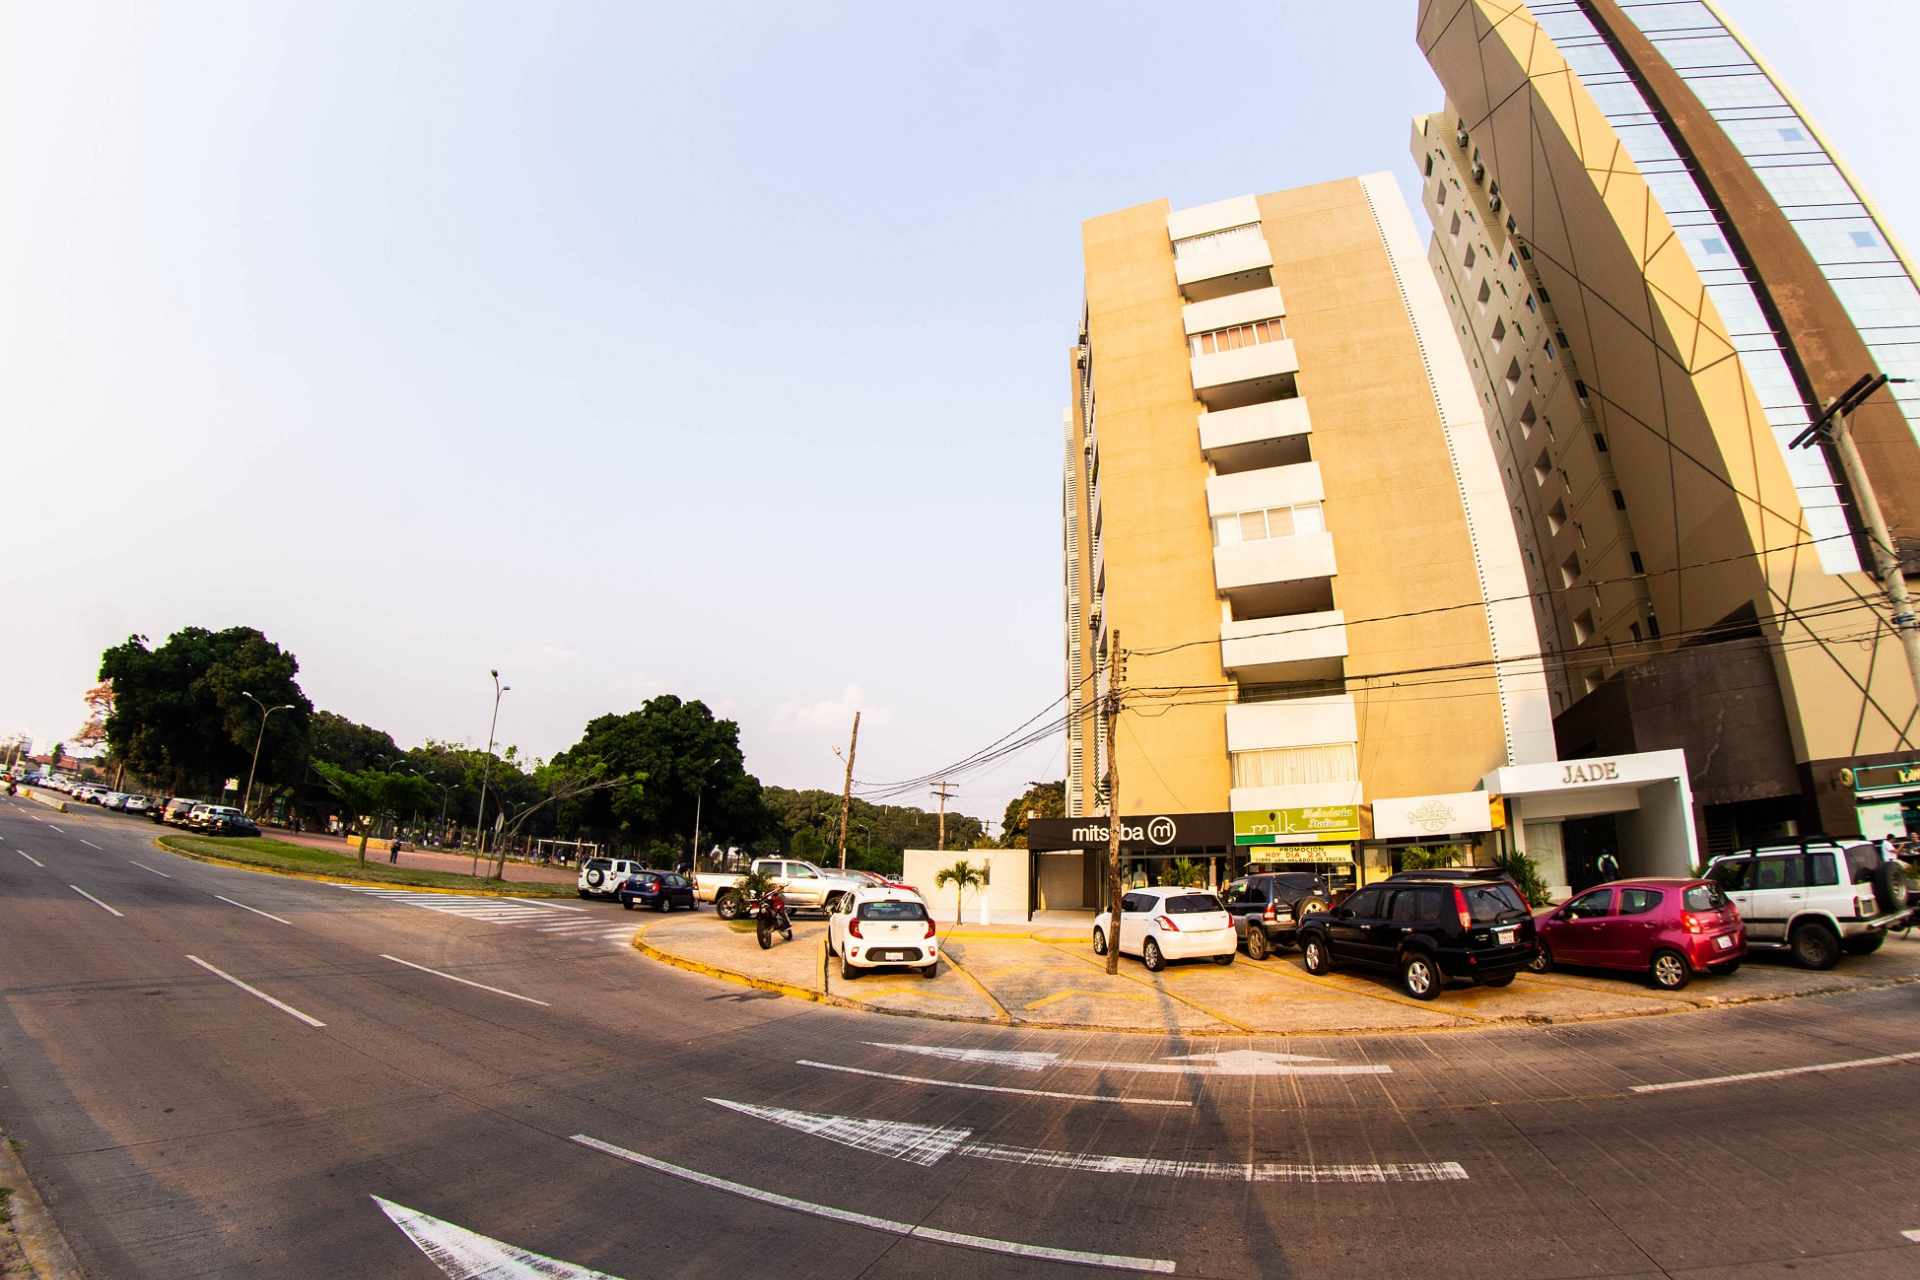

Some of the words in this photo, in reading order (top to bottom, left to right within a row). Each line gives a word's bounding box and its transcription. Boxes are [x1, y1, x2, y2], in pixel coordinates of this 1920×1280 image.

[1563, 762, 1619, 784] JADE
[1072, 824, 1144, 841] mitsba
[1250, 811, 1296, 834] milk
